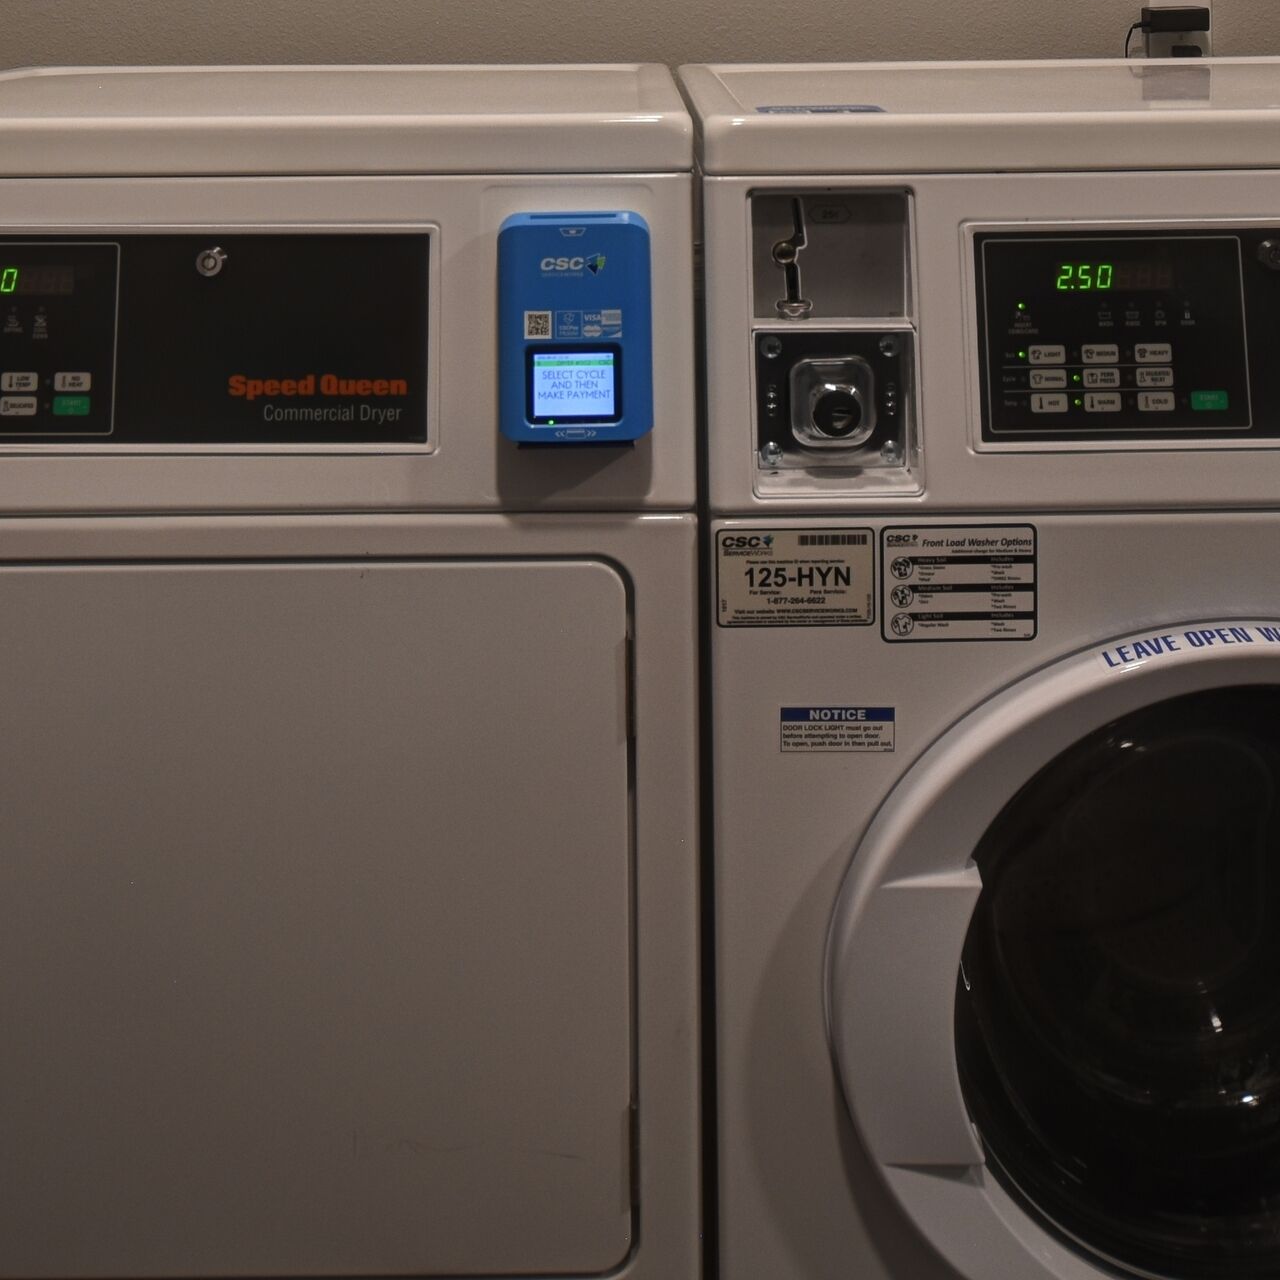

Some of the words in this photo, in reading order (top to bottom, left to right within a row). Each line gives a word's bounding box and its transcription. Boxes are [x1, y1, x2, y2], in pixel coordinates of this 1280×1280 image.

[540, 256, 584, 271] CSC
[1056, 264, 1113, 290] 2.50
[584, 314, 601, 322] VISA
[542, 369, 573, 380] SELECT
[576, 369, 606, 380] CYCLE
[228, 374, 315, 401] Speed
[320, 373, 408, 396] Queen
[551, 380, 572, 389] AND
[575, 380, 598, 389] THEN
[538, 390, 564, 400] MAKE
[567, 389, 611, 400] PAYMENT
[263, 404, 354, 421] Commercial
[360, 404, 402, 424] Dryer
[722, 536, 760, 548] CSC
[887, 534, 911, 542] CSC
[922, 539, 943, 547] Front
[946, 538, 966, 547] Load
[968, 538, 998, 547] Washer
[1000, 537, 1032, 547] Options
[745, 566, 850, 587] 125-HYN
[1102, 634, 1181, 668] LEAVE
[1184, 626, 1254, 648] OPEN
[809, 709, 867, 720] NOTICE
